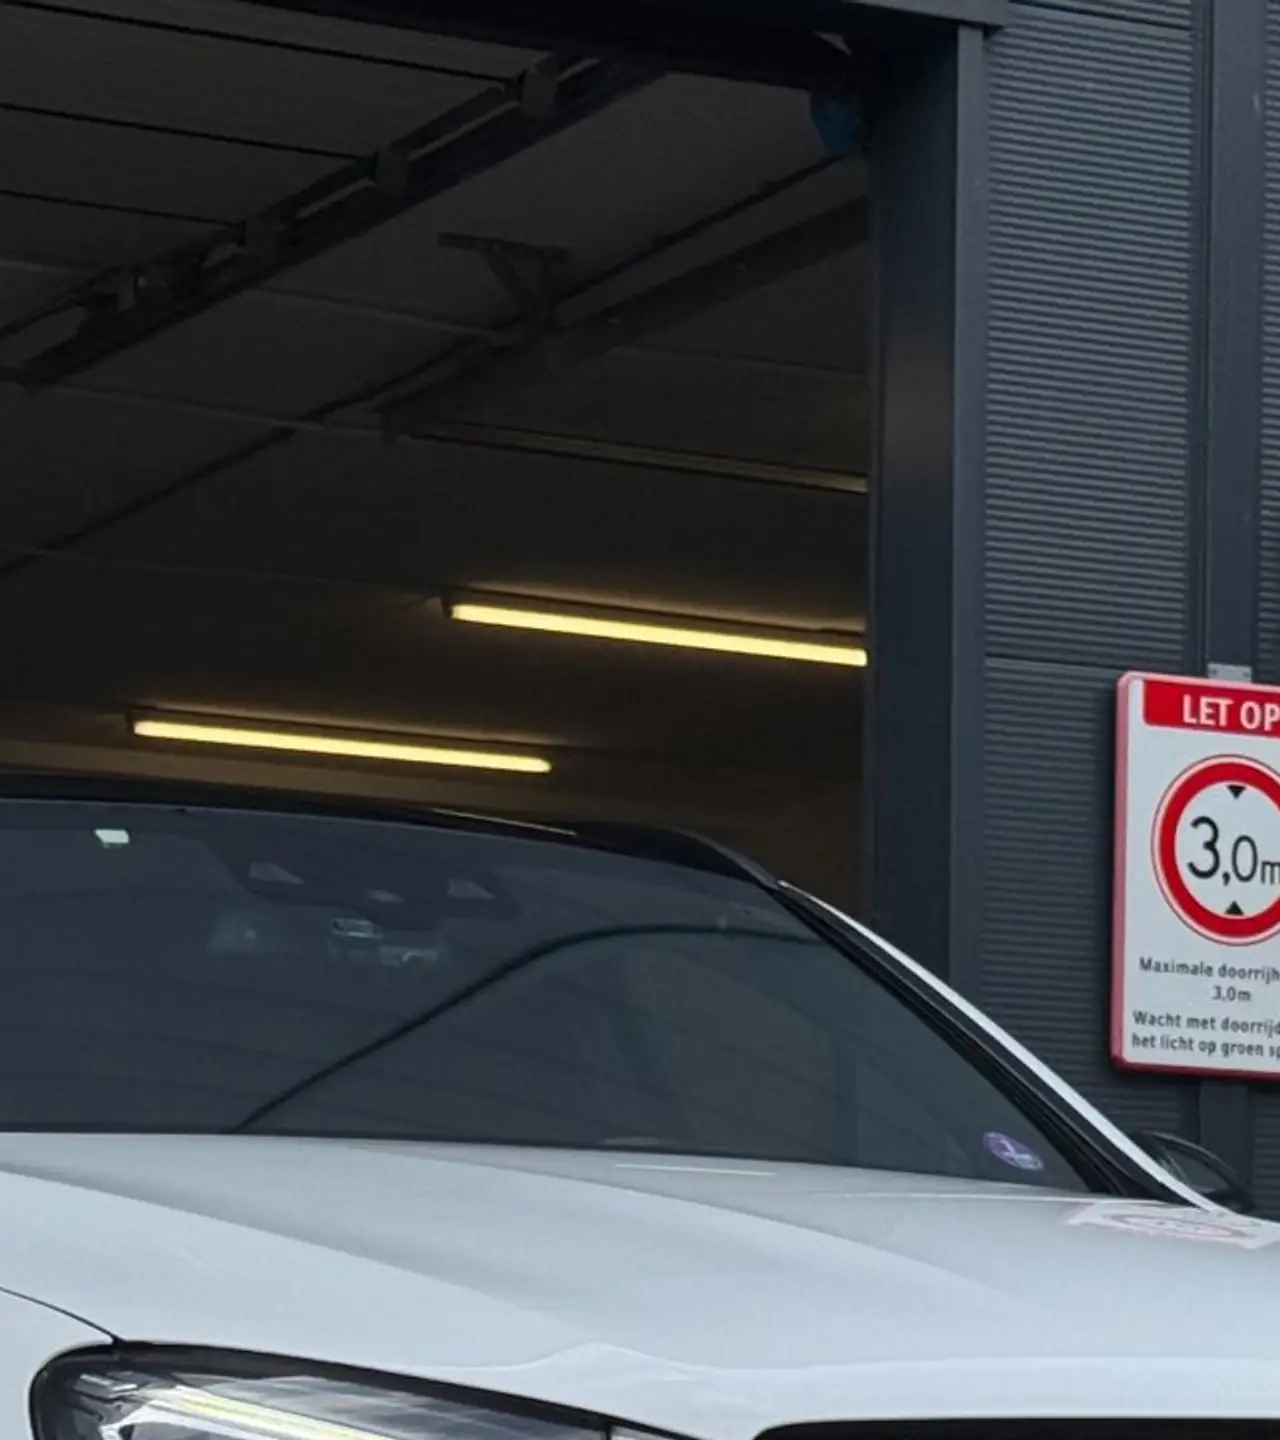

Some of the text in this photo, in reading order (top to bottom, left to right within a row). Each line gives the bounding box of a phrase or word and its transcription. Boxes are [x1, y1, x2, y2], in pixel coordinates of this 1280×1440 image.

[1182, 693, 1235, 728] LET
[1139, 956, 1214, 978] Maximale
[1131, 1010, 1182, 1029] Wacht
[1186, 1016, 1217, 1031] met
[1131, 1032, 1156, 1049] het
[1160, 1034, 1194, 1052] licht
[1197, 1040, 1217, 1056] op
[1220, 1042, 1264, 1058] groen
